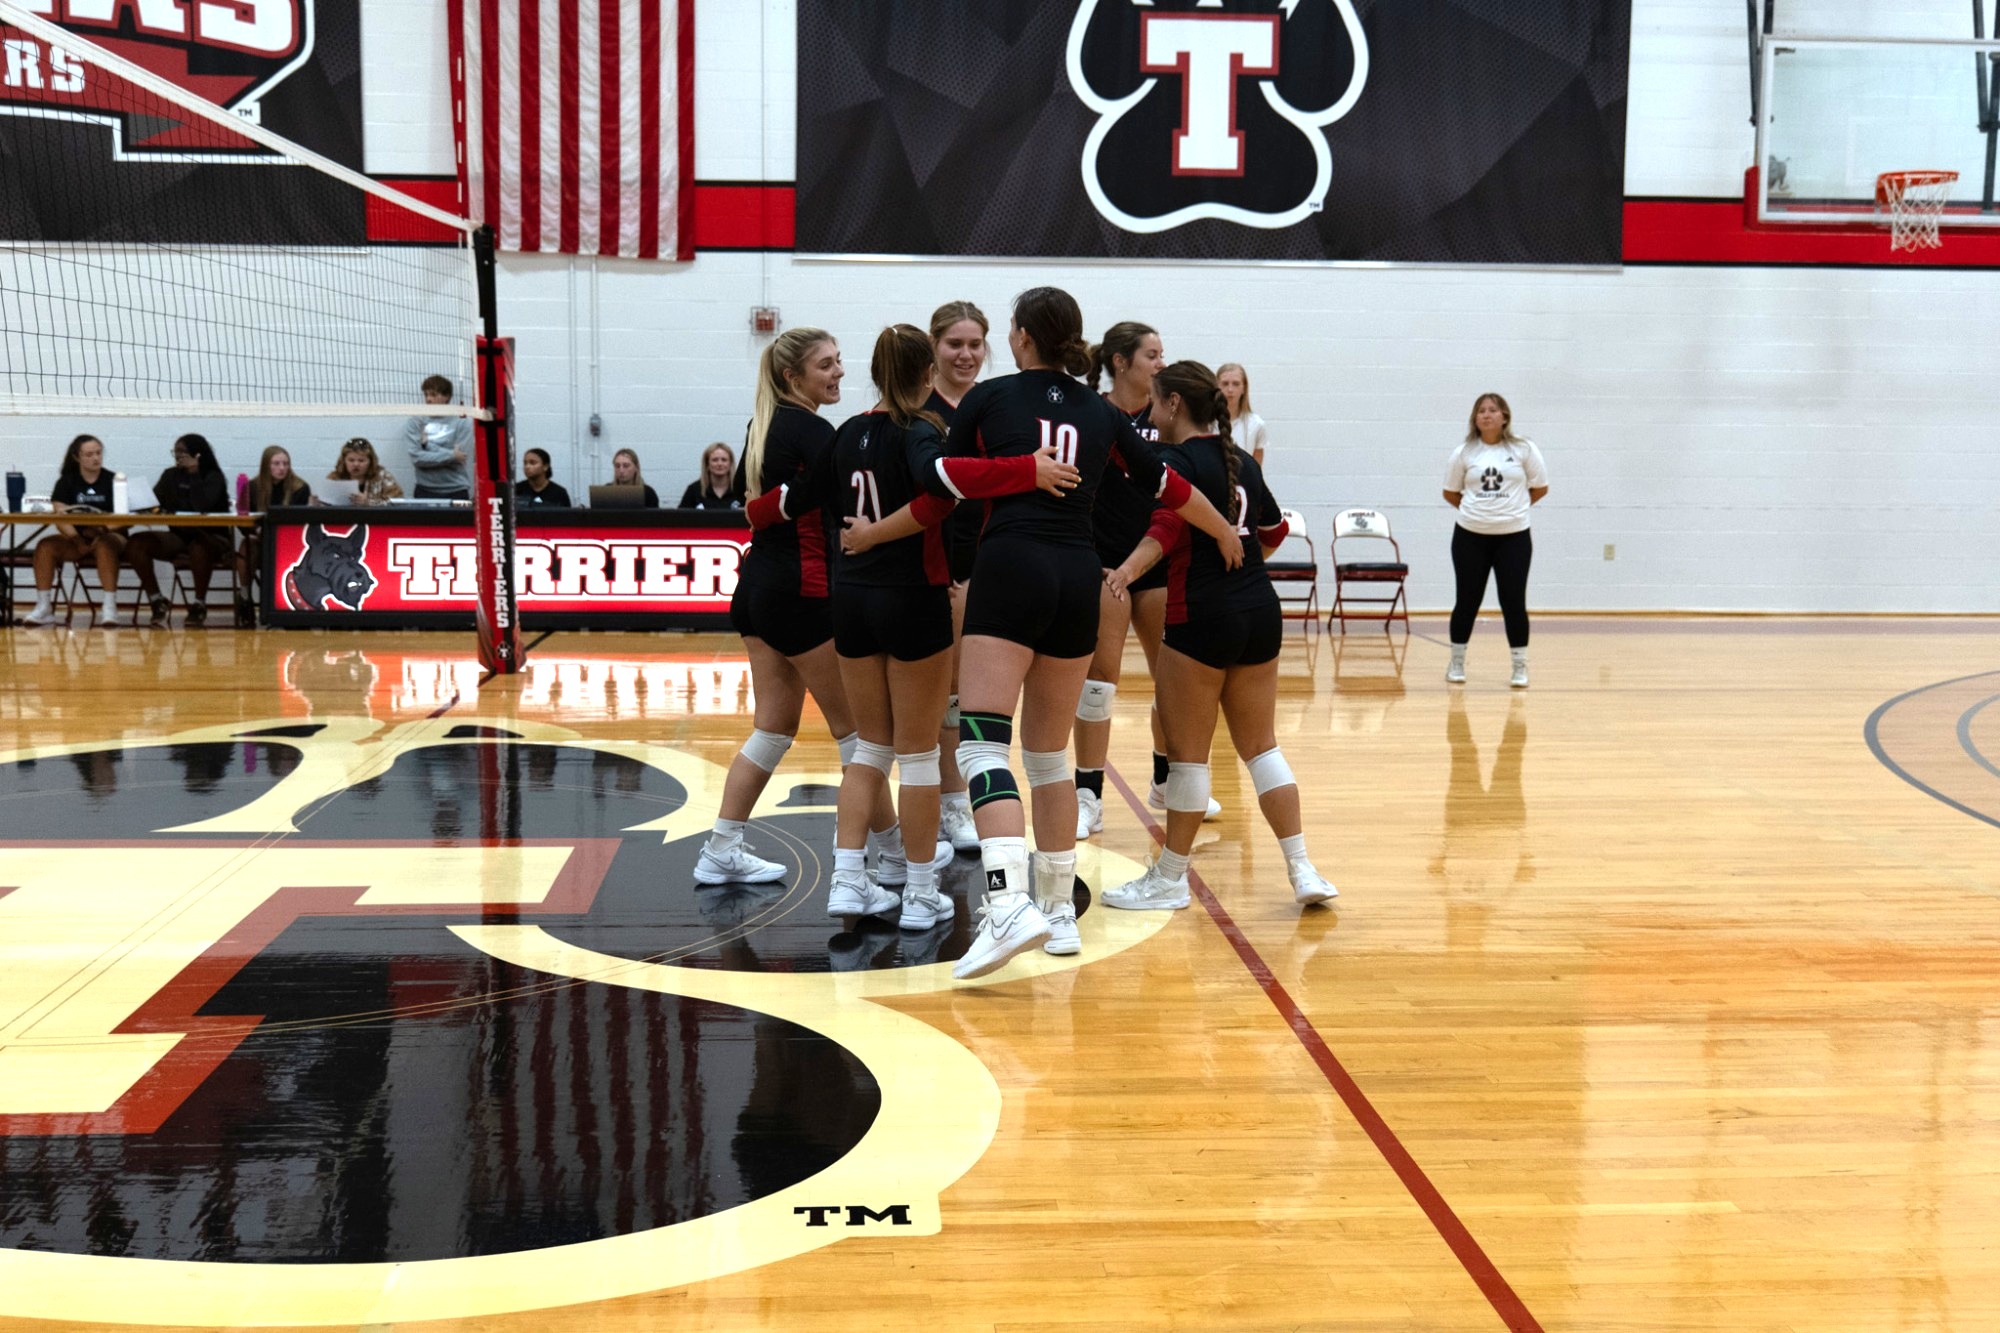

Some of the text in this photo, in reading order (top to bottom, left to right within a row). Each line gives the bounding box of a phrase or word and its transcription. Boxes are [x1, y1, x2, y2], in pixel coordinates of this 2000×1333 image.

[237, 109, 253, 118] TM
[1140, 12, 1280, 177] T
[1036, 417, 1078, 467] 10
[1135, 428, 1159, 442] ER
[851, 470, 882, 523] 21
[488, 498, 510, 629] TERRIERS
[793, 1205, 912, 1227] TM
